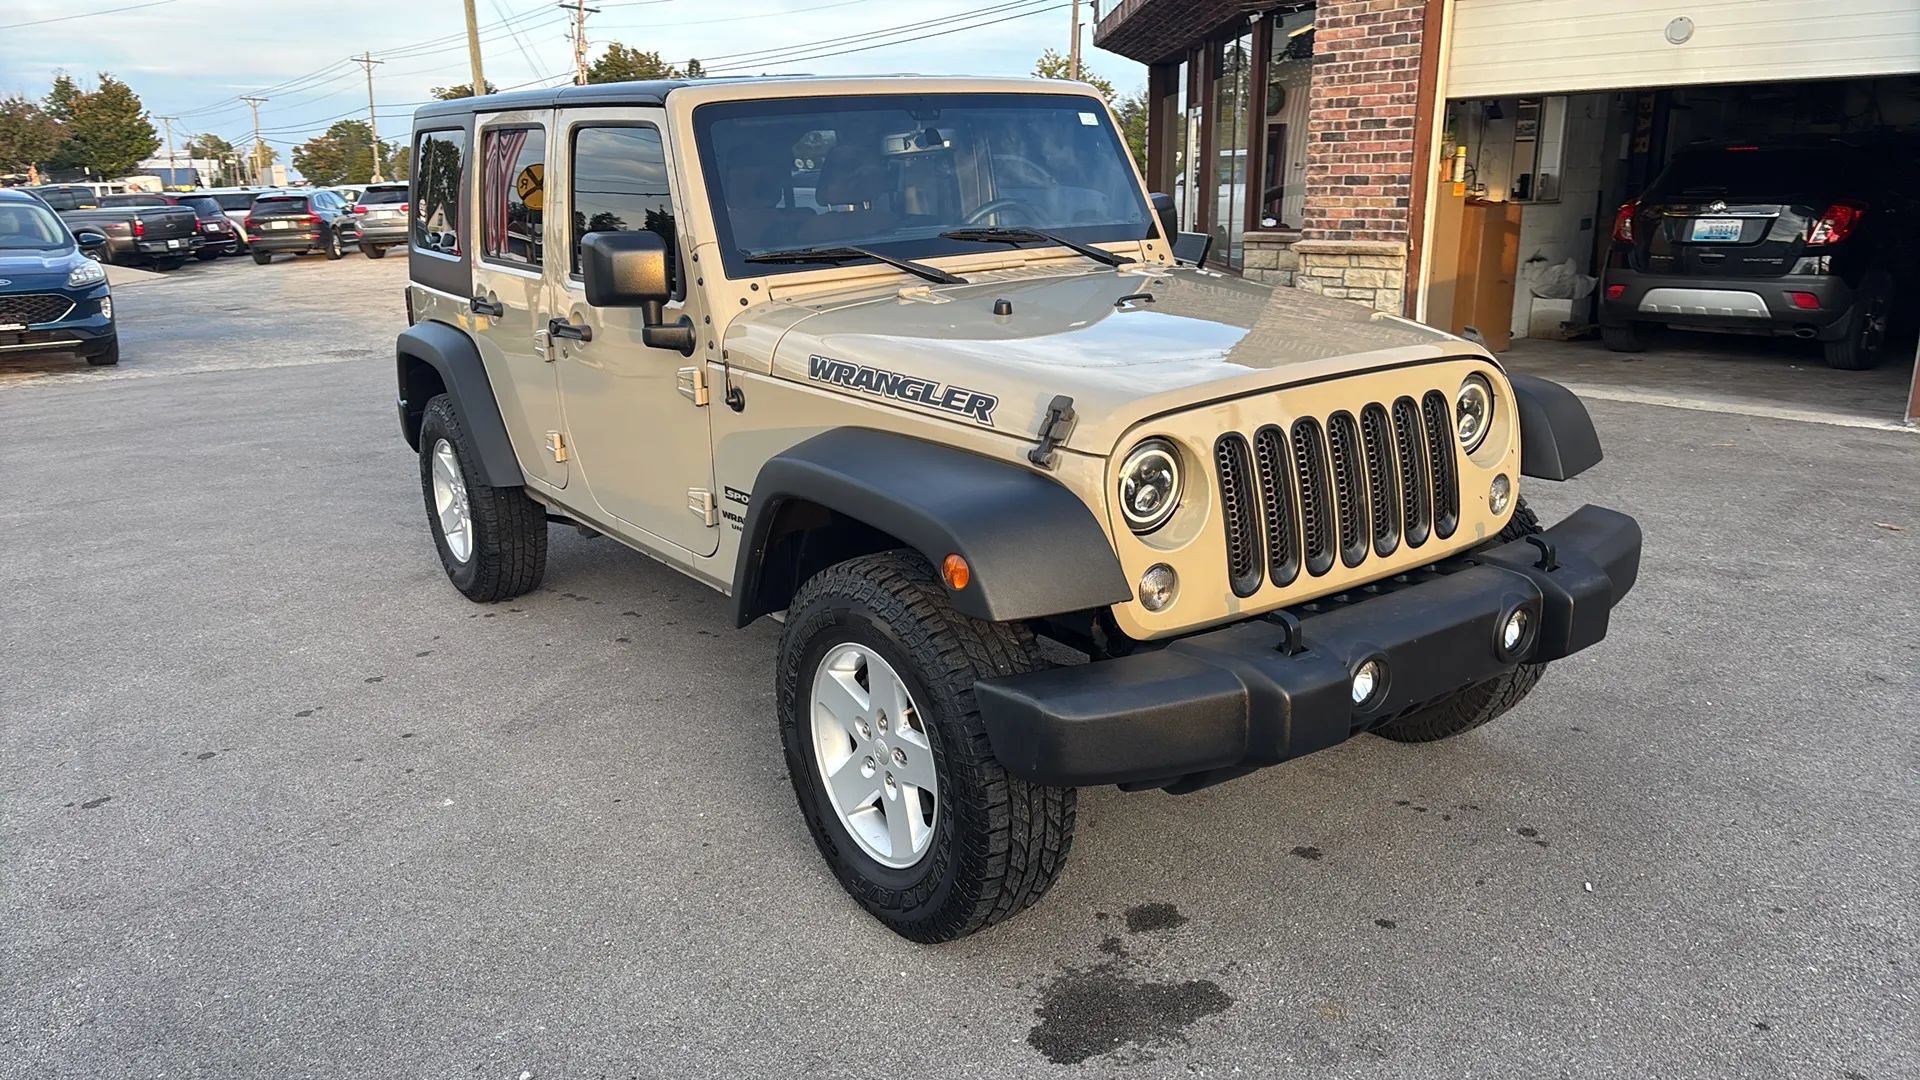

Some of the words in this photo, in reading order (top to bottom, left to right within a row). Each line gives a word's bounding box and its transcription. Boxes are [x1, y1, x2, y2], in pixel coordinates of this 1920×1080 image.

[808, 354, 999, 427] WRANGLER
[722, 510, 746, 524] WRA
[726, 490, 750, 503] SPO
[784, 609, 837, 729] YOKOHAMA
